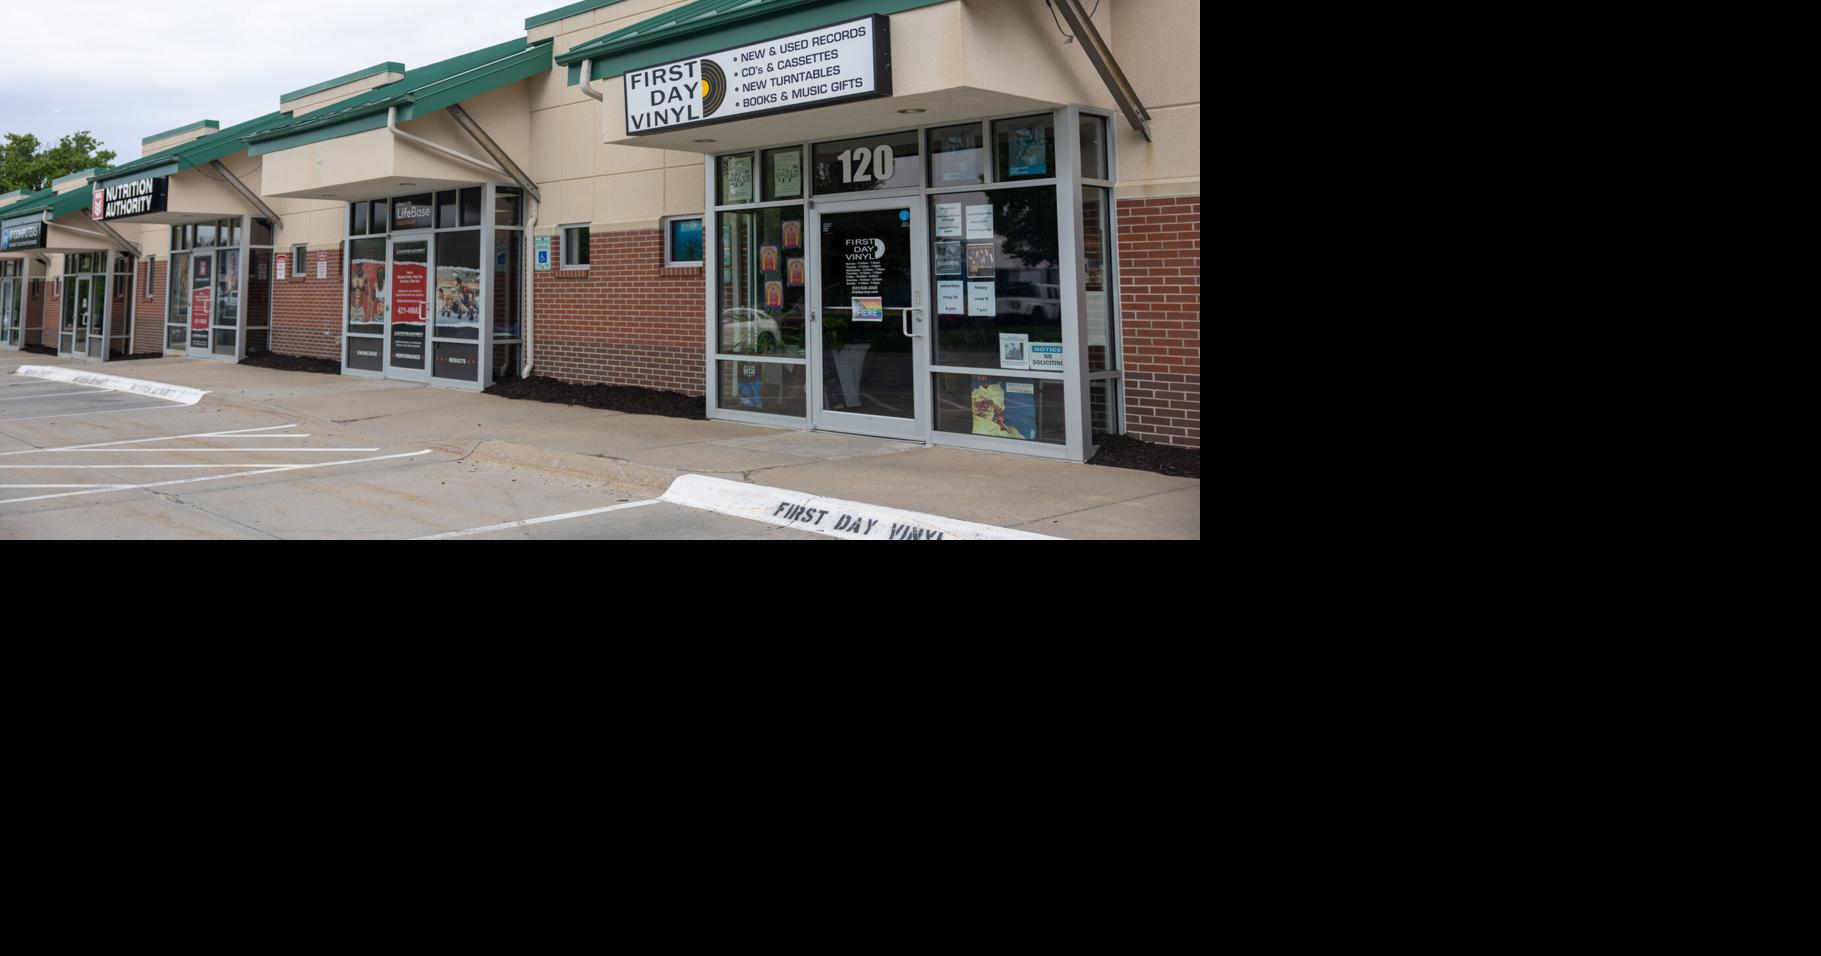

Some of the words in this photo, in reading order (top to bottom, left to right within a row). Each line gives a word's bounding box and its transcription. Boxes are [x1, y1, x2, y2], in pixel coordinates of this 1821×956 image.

[741, 49, 766, 63] NEW
[768, 47, 776, 56] &
[780, 39, 808, 54] USED
[812, 26, 866, 47] RECORDS
[630, 61, 698, 90] FIRST
[741, 66, 764, 78] CD's
[766, 63, 774, 73] &
[777, 49, 839, 70] CASSETTES
[742, 79, 767, 93] NEW
[770, 65, 841, 87] TURNTABLES
[651, 82, 699, 106] DAY
[743, 93, 777, 108] BOOKS
[780, 91, 788, 101] &
[792, 84, 828, 99] MUSIC
[831, 77, 863, 92] GIFTS
[631, 104, 700, 130] VINYL
[837, 144, 894, 184] 120
[106, 177, 153, 202] NUTRITION
[105, 194, 153, 218] AUTHORITY
[396, 206, 431, 219] LifeBase
[845, 238, 875, 246] FIRST
[857, 309, 878, 317] HERE
[773, 502, 828, 525] FIRST
[834, 514, 878, 535] DAY
